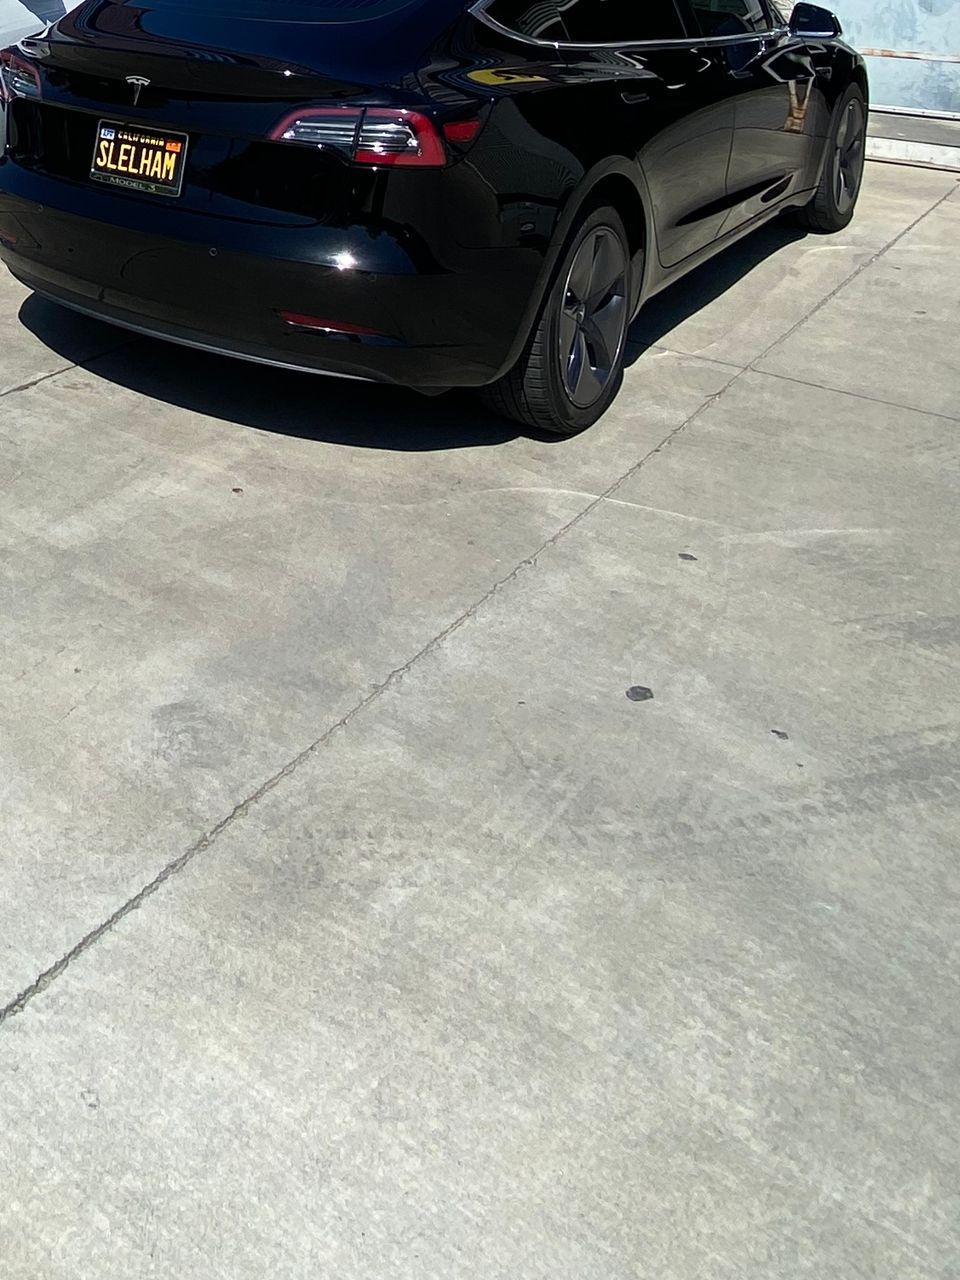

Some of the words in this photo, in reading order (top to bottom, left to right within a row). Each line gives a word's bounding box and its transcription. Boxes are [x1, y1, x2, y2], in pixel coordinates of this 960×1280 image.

[118, 130, 165, 147] CALIFORNIA
[96, 140, 177, 181] SLELHAM
[109, 177, 146, 191] MODEL
